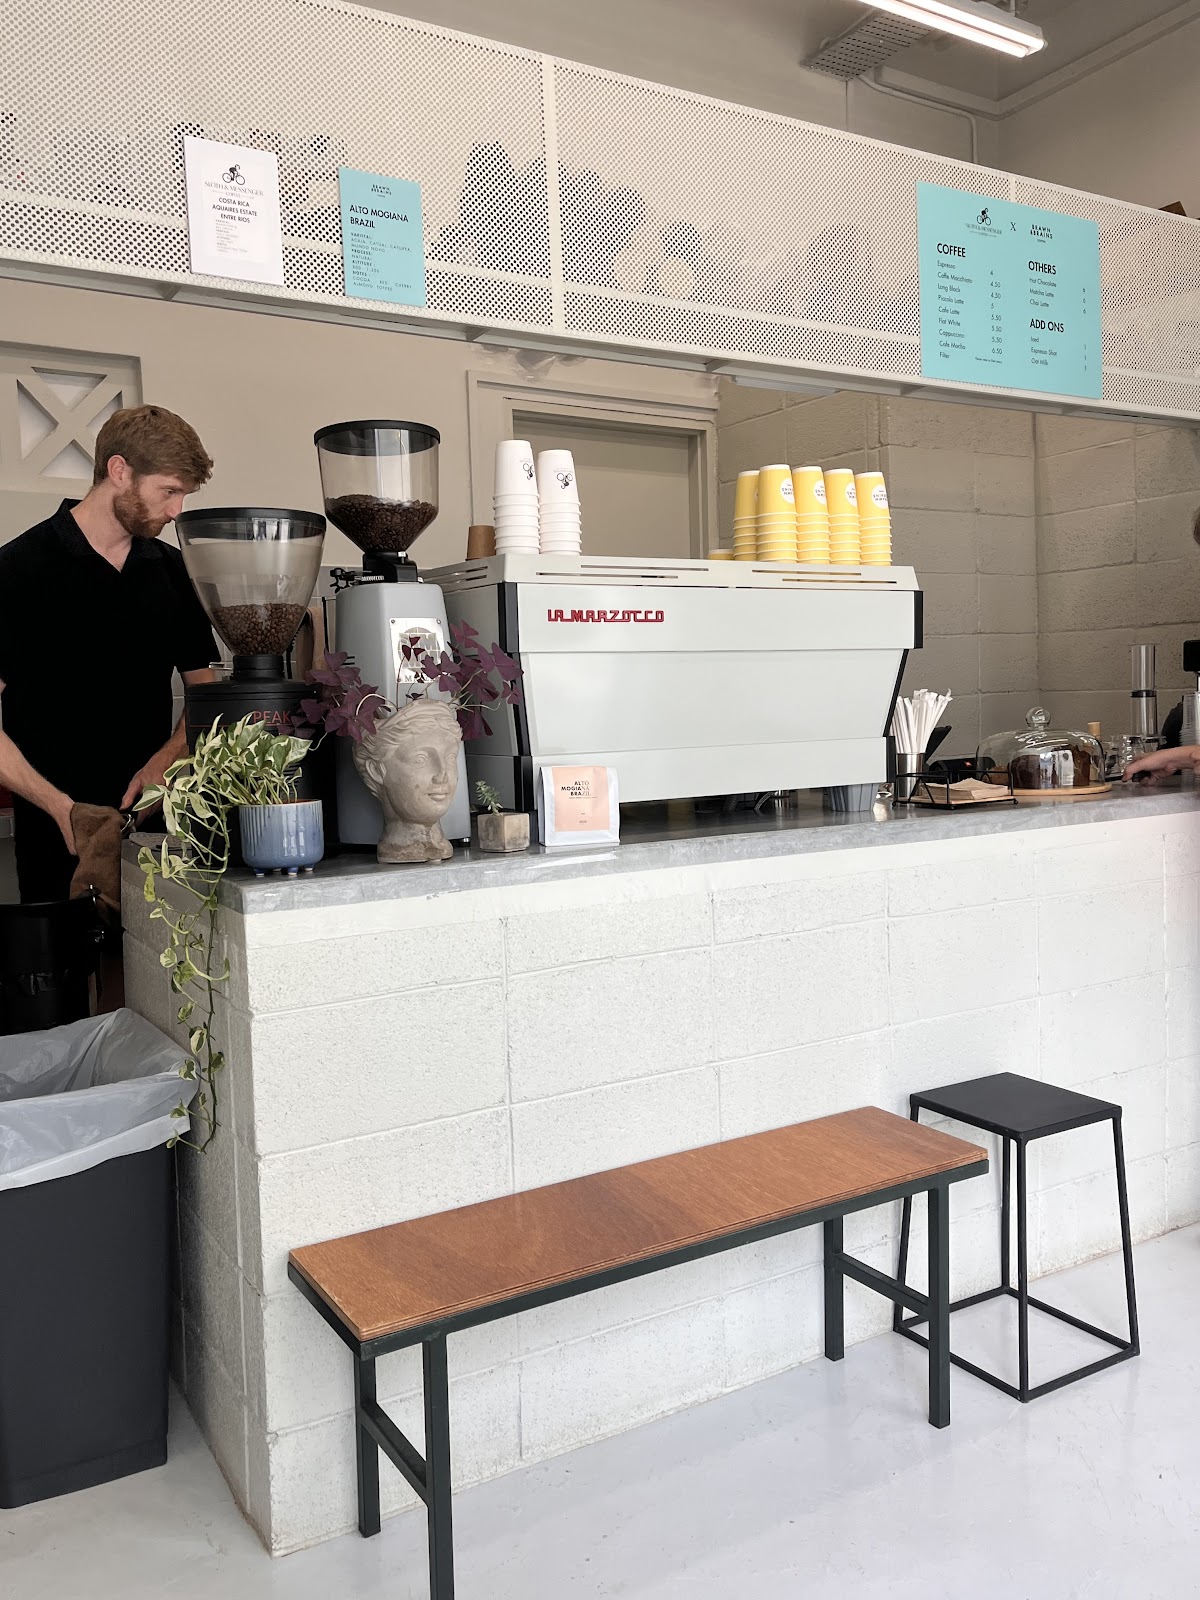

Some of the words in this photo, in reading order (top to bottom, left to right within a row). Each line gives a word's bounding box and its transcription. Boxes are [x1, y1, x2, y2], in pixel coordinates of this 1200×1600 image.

[230, 185, 264, 196] MESSENGER
[219, 197, 237, 205] COSTA
[212, 204, 239, 214] AQUAIRES
[240, 208, 257, 217] ESTATE
[349, 204, 369, 215] ALTO
[370, 208, 409, 223] MOGIANA
[220, 213, 236, 221] ENTRE
[238, 216, 250, 224] RIOS
[350, 216, 376, 229] BRAZIL
[1010, 221, 1017, 232] X
[1031, 223, 1050, 232] BRAWN
[936, 242, 966, 258] COFFEE
[937, 260, 956, 269] Espresso
[1028, 260, 1057, 275] OTHERS
[990, 280, 1001, 288] 4.50
[1036, 278, 1057, 288] Chocolate
[937, 282, 949, 293] Long
[949, 284, 961, 293] Black
[990, 292, 1002, 300] 4.50
[1029, 288, 1045, 296] Matcha
[1044, 290, 1055, 298] Latte
[938, 294, 954, 303] Piccolo
[1029, 298, 1039, 306] Chai
[1040, 300, 1050, 308] Latte
[990, 314, 1002, 322] 5.50
[938, 317, 947, 325] Flat
[947, 318, 961, 327] White
[991, 325, 1002, 333] 5.50
[1029, 317, 1046, 330] ADD
[1047, 321, 1065, 333] ONS
[938, 328, 965, 338] Cappuccino
[991, 336, 1003, 344] 5.50
[950, 342, 966, 350] Mocha
[991, 347, 1003, 355] 6.50
[1030, 346, 1048, 355] Espresso
[1048, 349, 1058, 357] Shot
[939, 351, 950, 359] Filter
[1030, 357, 1040, 365] Oat
[547, 609, 564, 622] LA
[570, 609, 664, 623] MARZOCCO
[253, 710, 291, 724] PEAK
